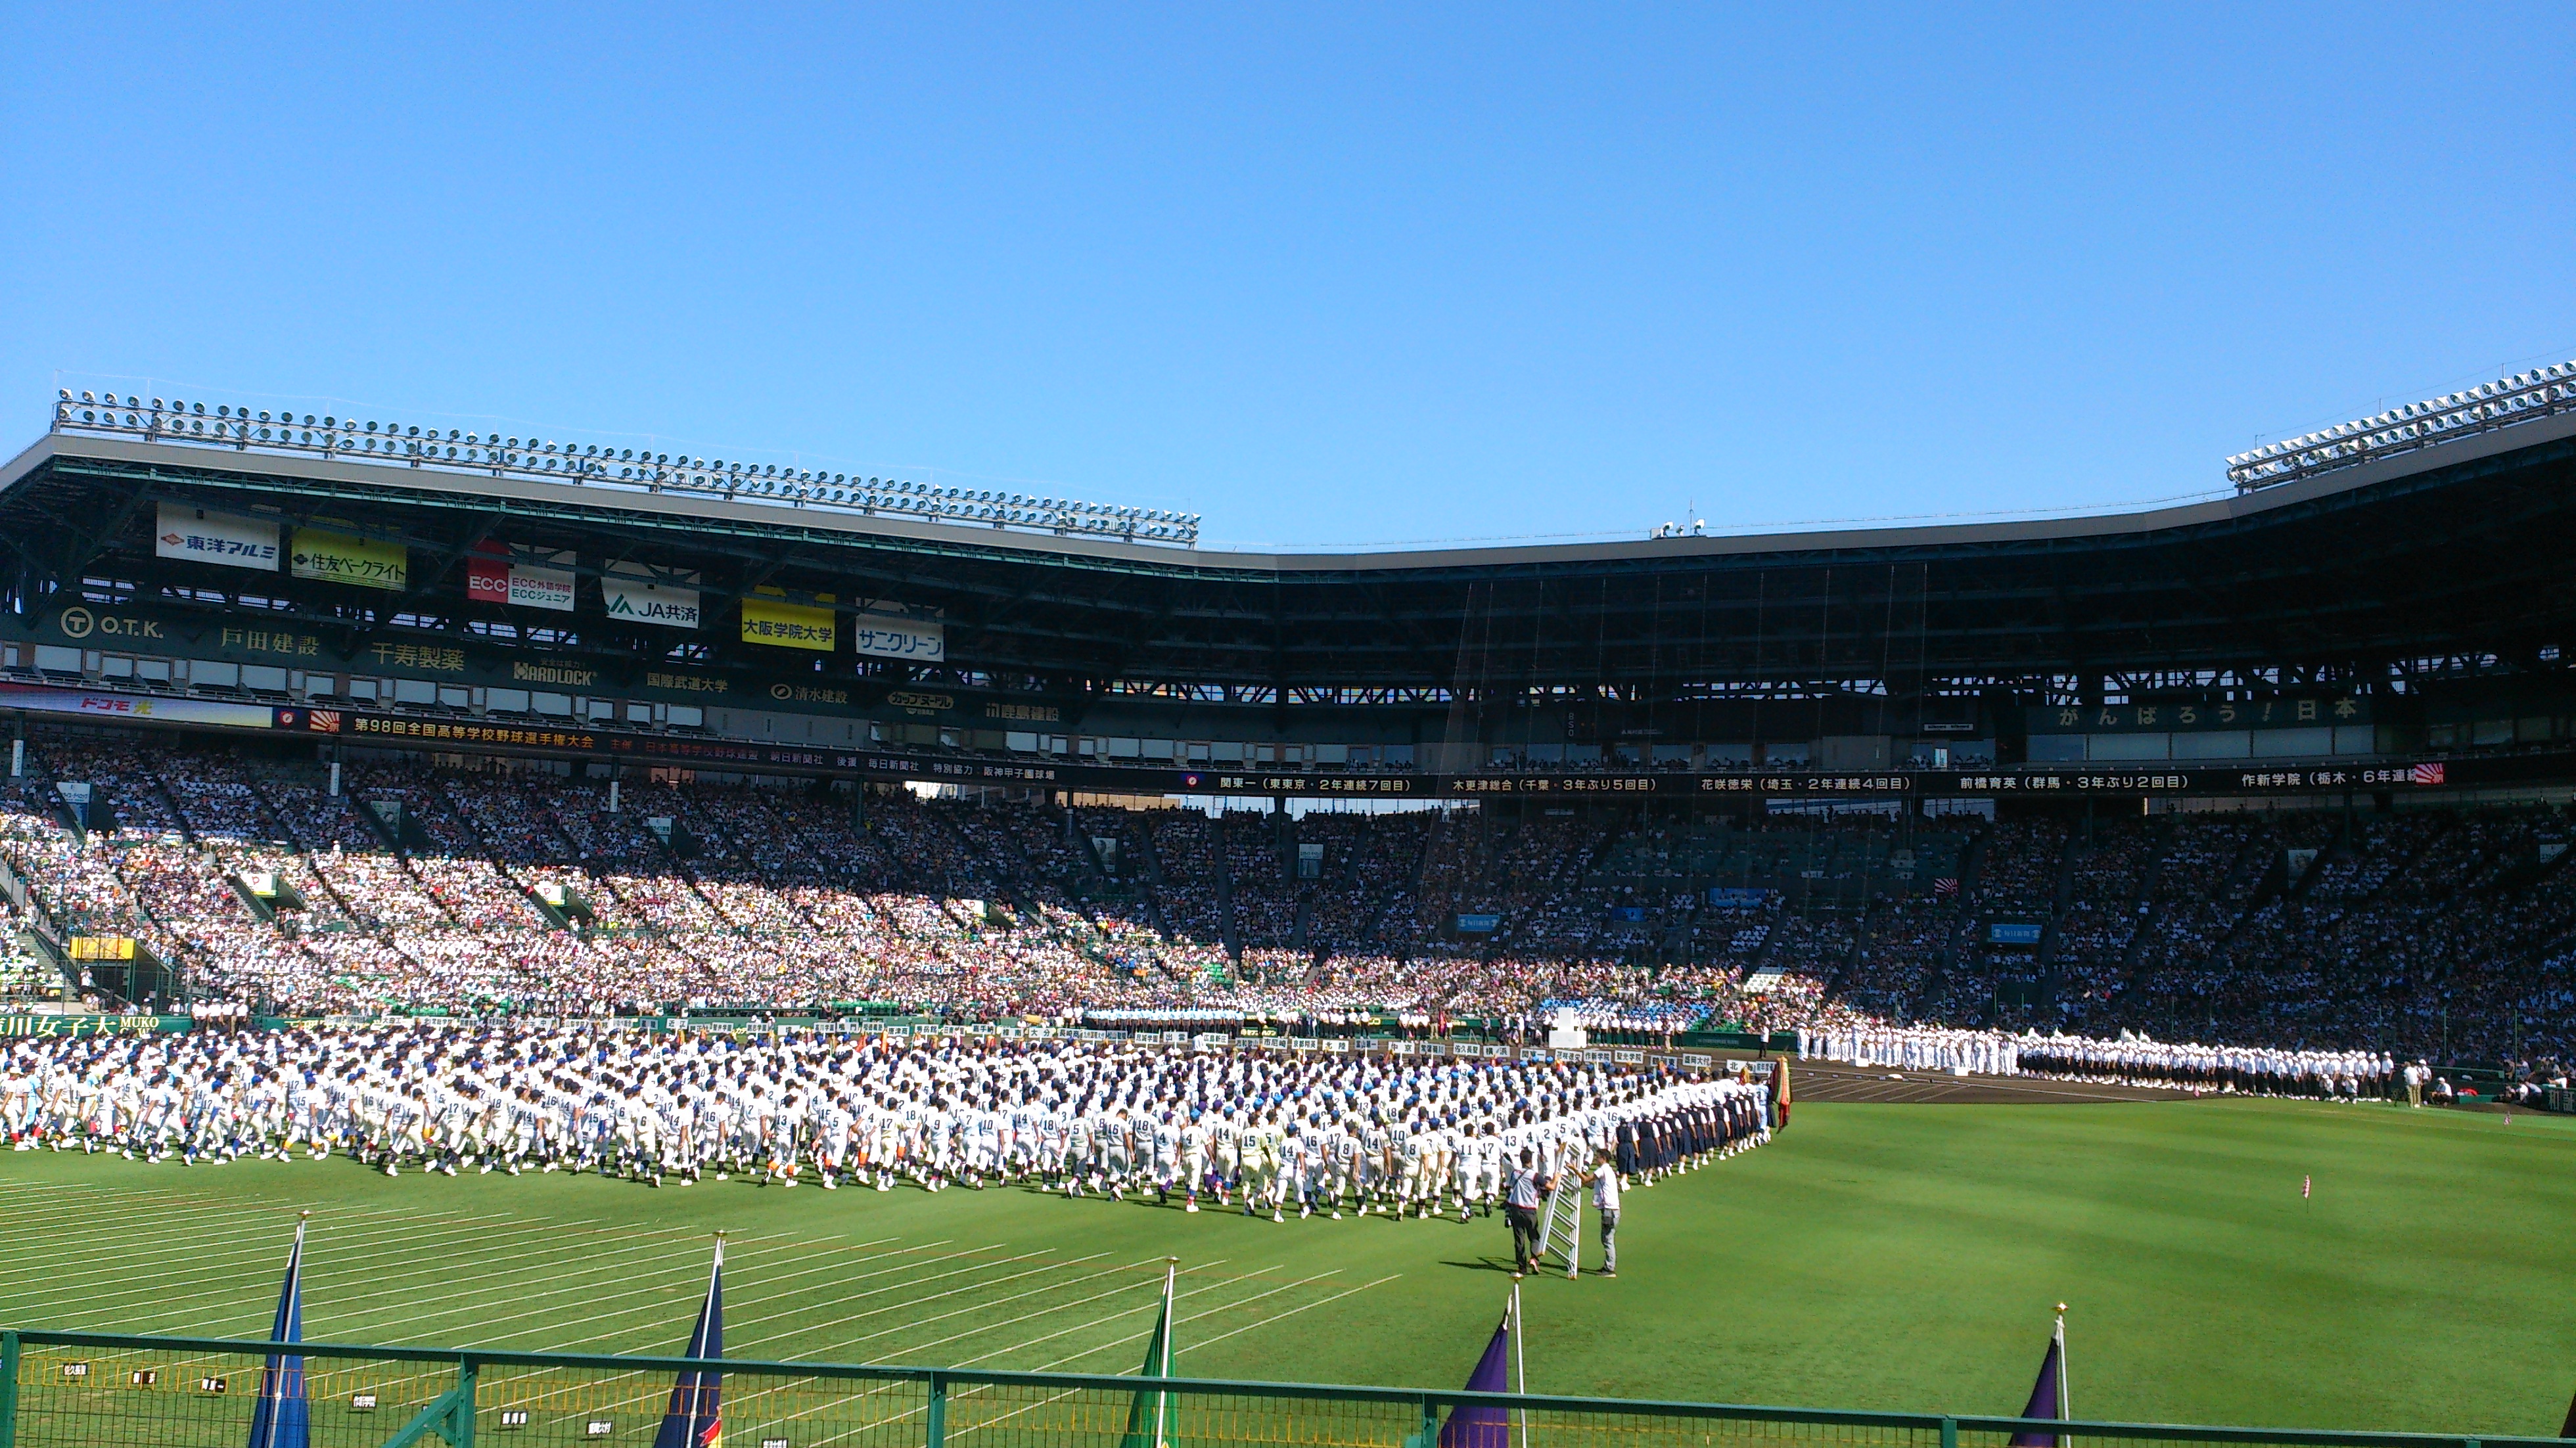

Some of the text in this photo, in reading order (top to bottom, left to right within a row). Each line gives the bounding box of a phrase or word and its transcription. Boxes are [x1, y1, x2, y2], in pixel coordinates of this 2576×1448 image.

[187, 535, 276, 559] 東洋アルミ
[310, 553, 404, 581] 住友ベークライト
[469, 576, 507, 593] ECC
[638, 602, 697, 622] JA共済
[100, 616, 164, 639] O.T.K.
[743, 619, 833, 643] 大阪学院大学
[221, 627, 320, 656] 戸田建設
[860, 629, 941, 655] サニクリーン
[371, 642, 465, 671] 千寿製薬
[647, 672, 728, 694] 国際武道大学
[795, 686, 848, 704] 清水建設
[354, 717, 594, 748] 第98回全国高等学校野球選手権大会
[705, 1111, 716, 1121] 16
[777, 1114, 787, 1125] 13
[906, 1110, 916, 1120] 18
[1018, 1113, 1027, 1123] 14
[833, 1117, 839, 1127] 5
[882, 1118, 892, 1129] 17
[934, 1120, 940, 1130] 9
[983, 1120, 993, 1130] 10
[1044, 1120, 1054, 1130] 18
[1138, 1121, 1148, 1131] 18
[1073, 1124, 1080, 1134] 5
[1108, 1123, 1118, 1134] 16
[1218, 1128, 1229, 1139] 14
[1159, 1132, 1166, 1143] 4
[1186, 1133, 1193, 1144] 4
[1244, 1135, 1256, 1146] 15
[1306, 1135, 1317, 1147] 16
[1393, 1130, 1404, 1141] 10
[1447, 1136, 1453, 1146] 8
[1505, 1136, 1517, 1146] 13
[1367, 1137, 1378, 1148] 14
[1282, 1145, 1293, 1157] 14
[1343, 1144, 1350, 1155] 8
[1410, 1144, 1416, 1156] 8
